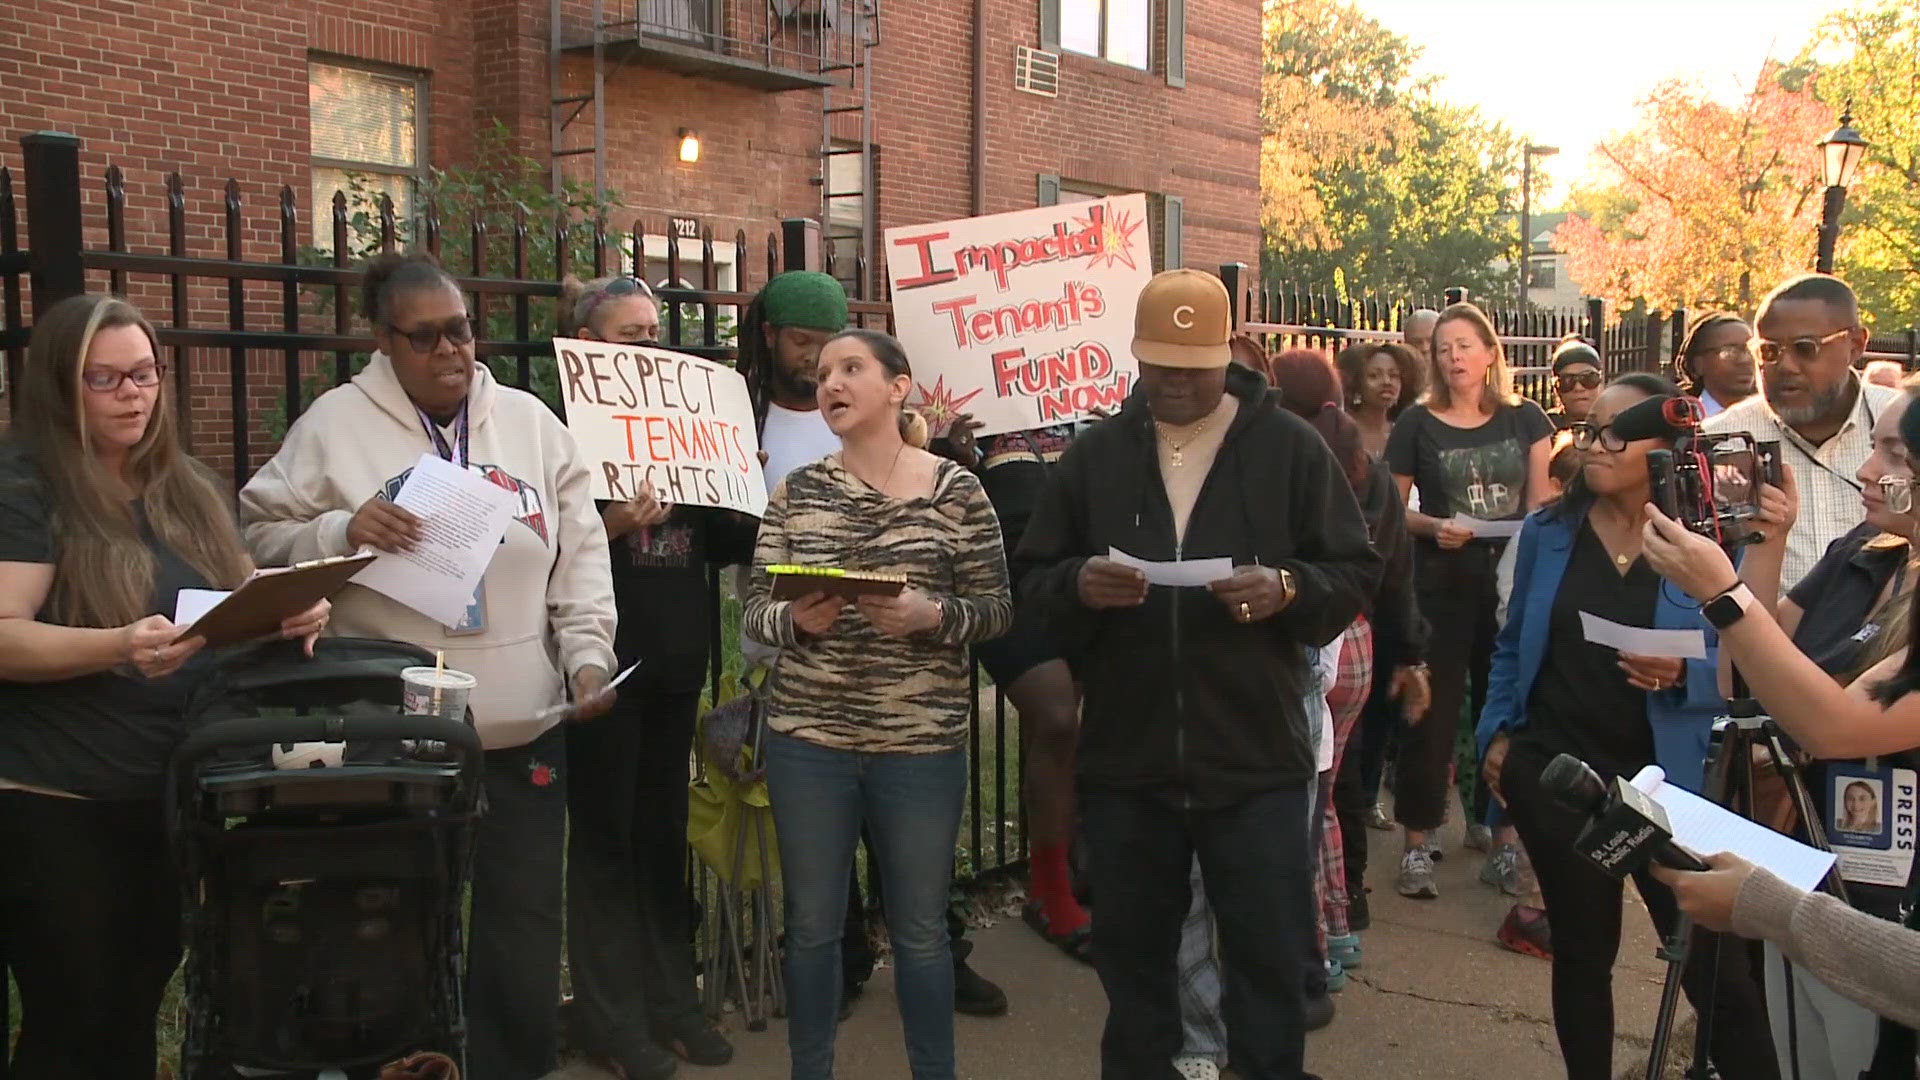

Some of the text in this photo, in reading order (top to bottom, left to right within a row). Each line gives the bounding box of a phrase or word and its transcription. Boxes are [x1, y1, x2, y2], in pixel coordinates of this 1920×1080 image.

[932, 281, 1105, 349] Tenant's
[1173, 305, 1195, 329] C
[561, 349, 716, 416] RESPECT
[991, 341, 1112, 398] FUND
[612, 414, 749, 473] TENANTS
[1898, 784, 1912, 850] PRESS
[1601, 825, 1655, 869] Public Radio
